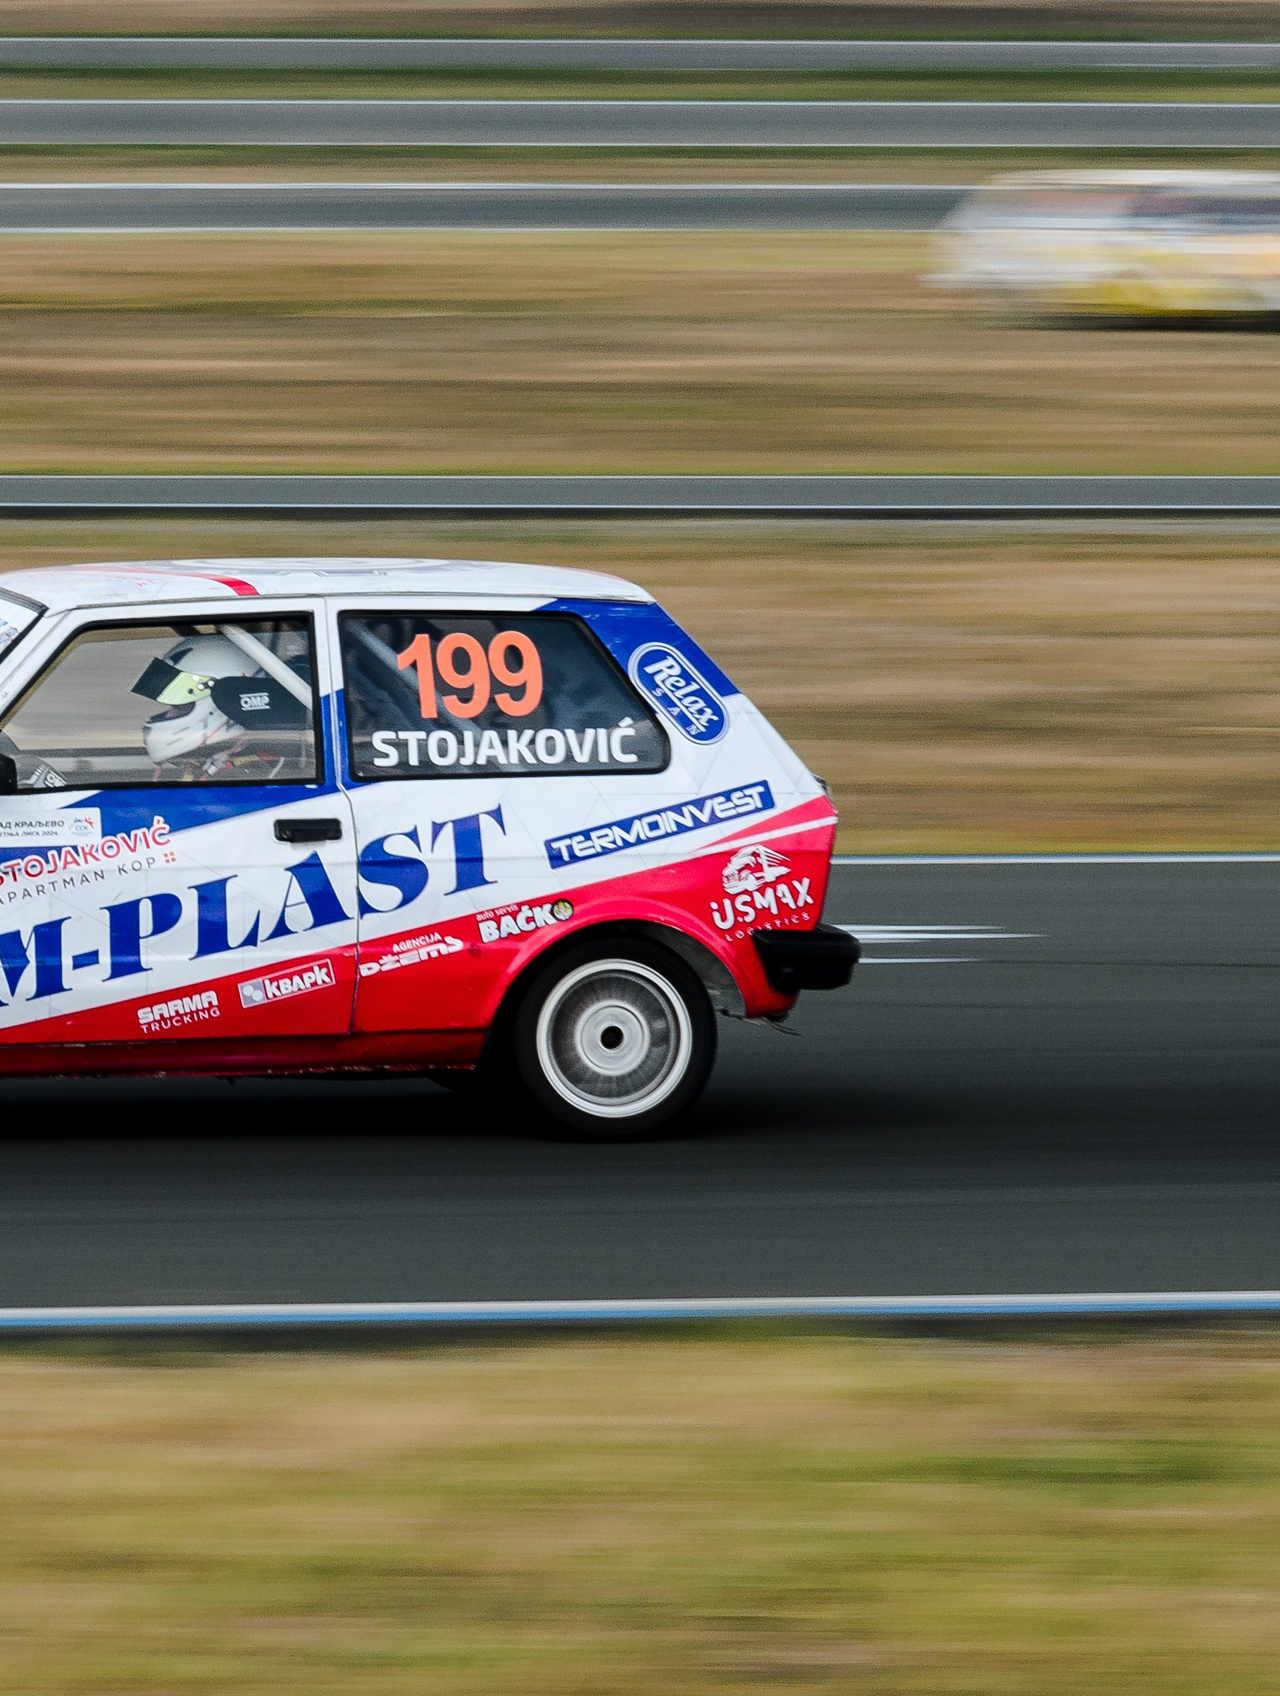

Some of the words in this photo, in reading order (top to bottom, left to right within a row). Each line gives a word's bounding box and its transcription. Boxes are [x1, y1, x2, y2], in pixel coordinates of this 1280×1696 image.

[397, 630, 543, 719] 199
[643, 655, 719, 726] Relax
[240, 695, 269, 709] OMP
[651, 687, 701, 735] SAN
[371, 716, 638, 767] STOJAKOVIĆ
[550, 786, 765, 862] TERMOINVEST
[117, 856, 157, 876] KOP
[392, 931, 442, 954] AGENCIJA
[137, 990, 219, 1025] SARMA
[141, 1007, 220, 1034] TRUCKING
